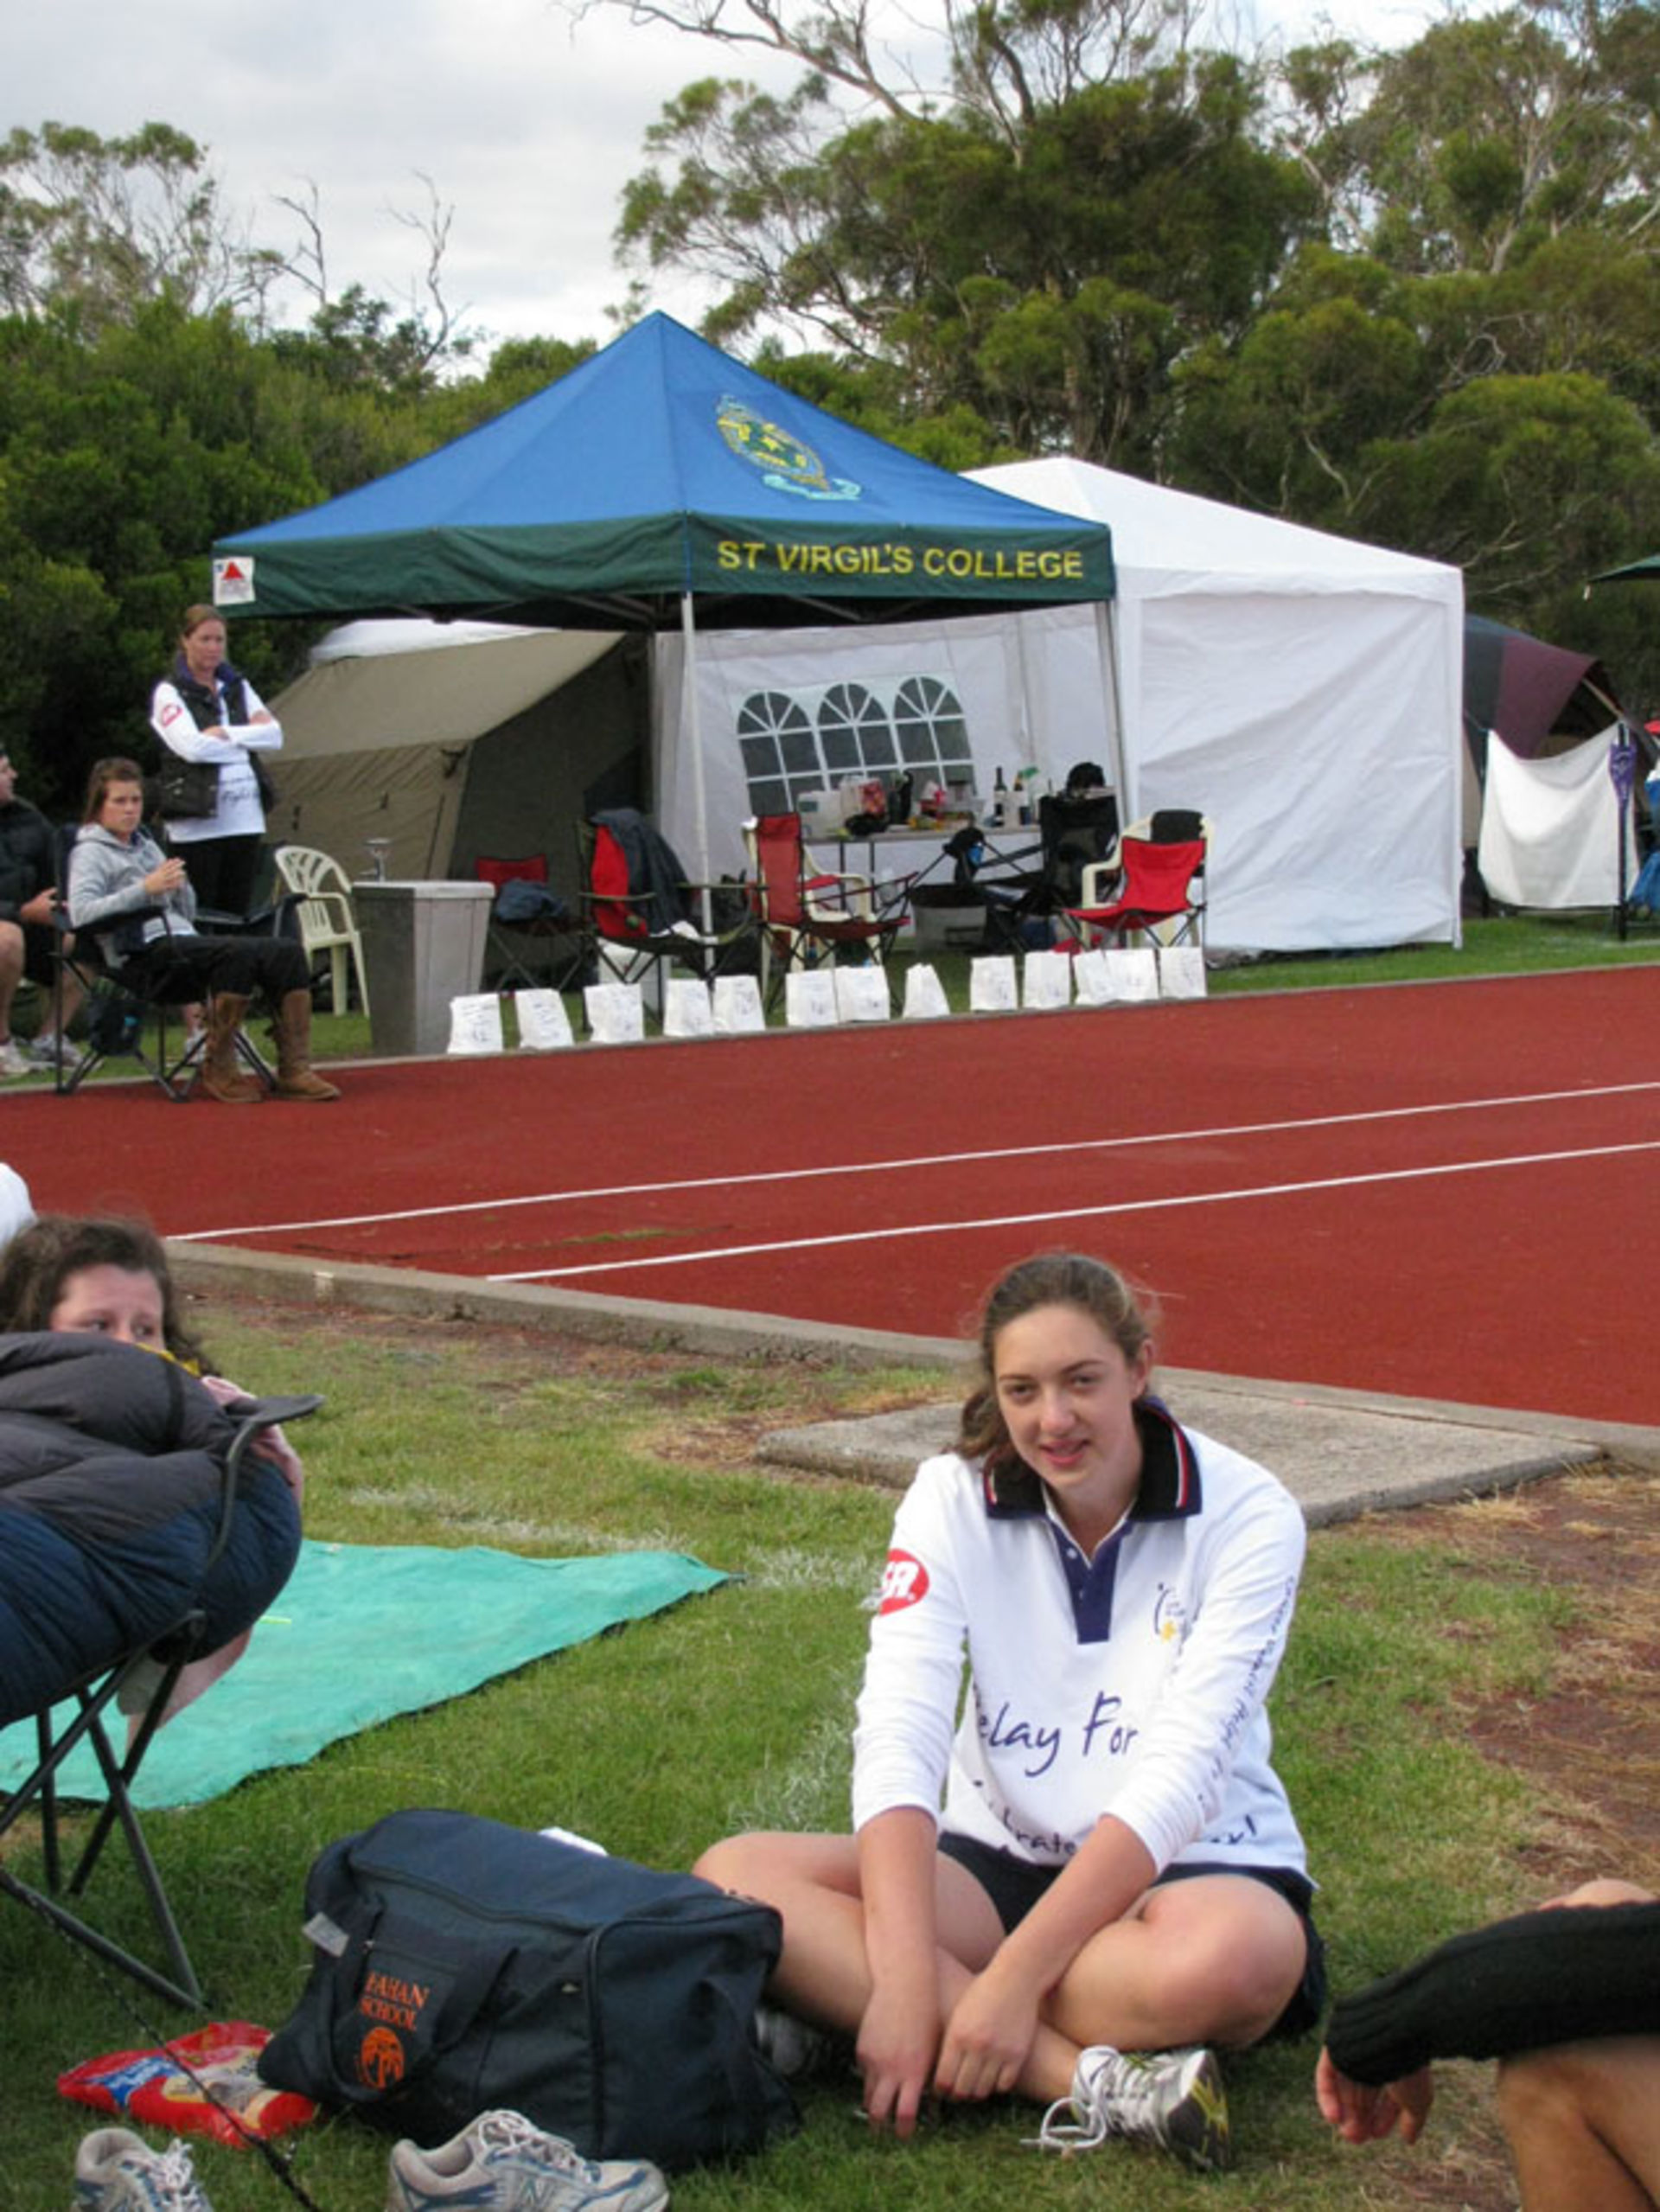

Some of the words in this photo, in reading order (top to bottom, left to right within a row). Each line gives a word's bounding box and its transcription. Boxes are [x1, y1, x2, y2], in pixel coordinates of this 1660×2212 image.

[717, 540, 766, 571] ST
[776, 542, 915, 574] VIRGIL'S
[923, 547, 1084, 579] COLLEGE
[976, 1700, 1060, 1777] elay
[1082, 1690, 1138, 1757] For
[360, 1996, 418, 2032] SCHOOL
